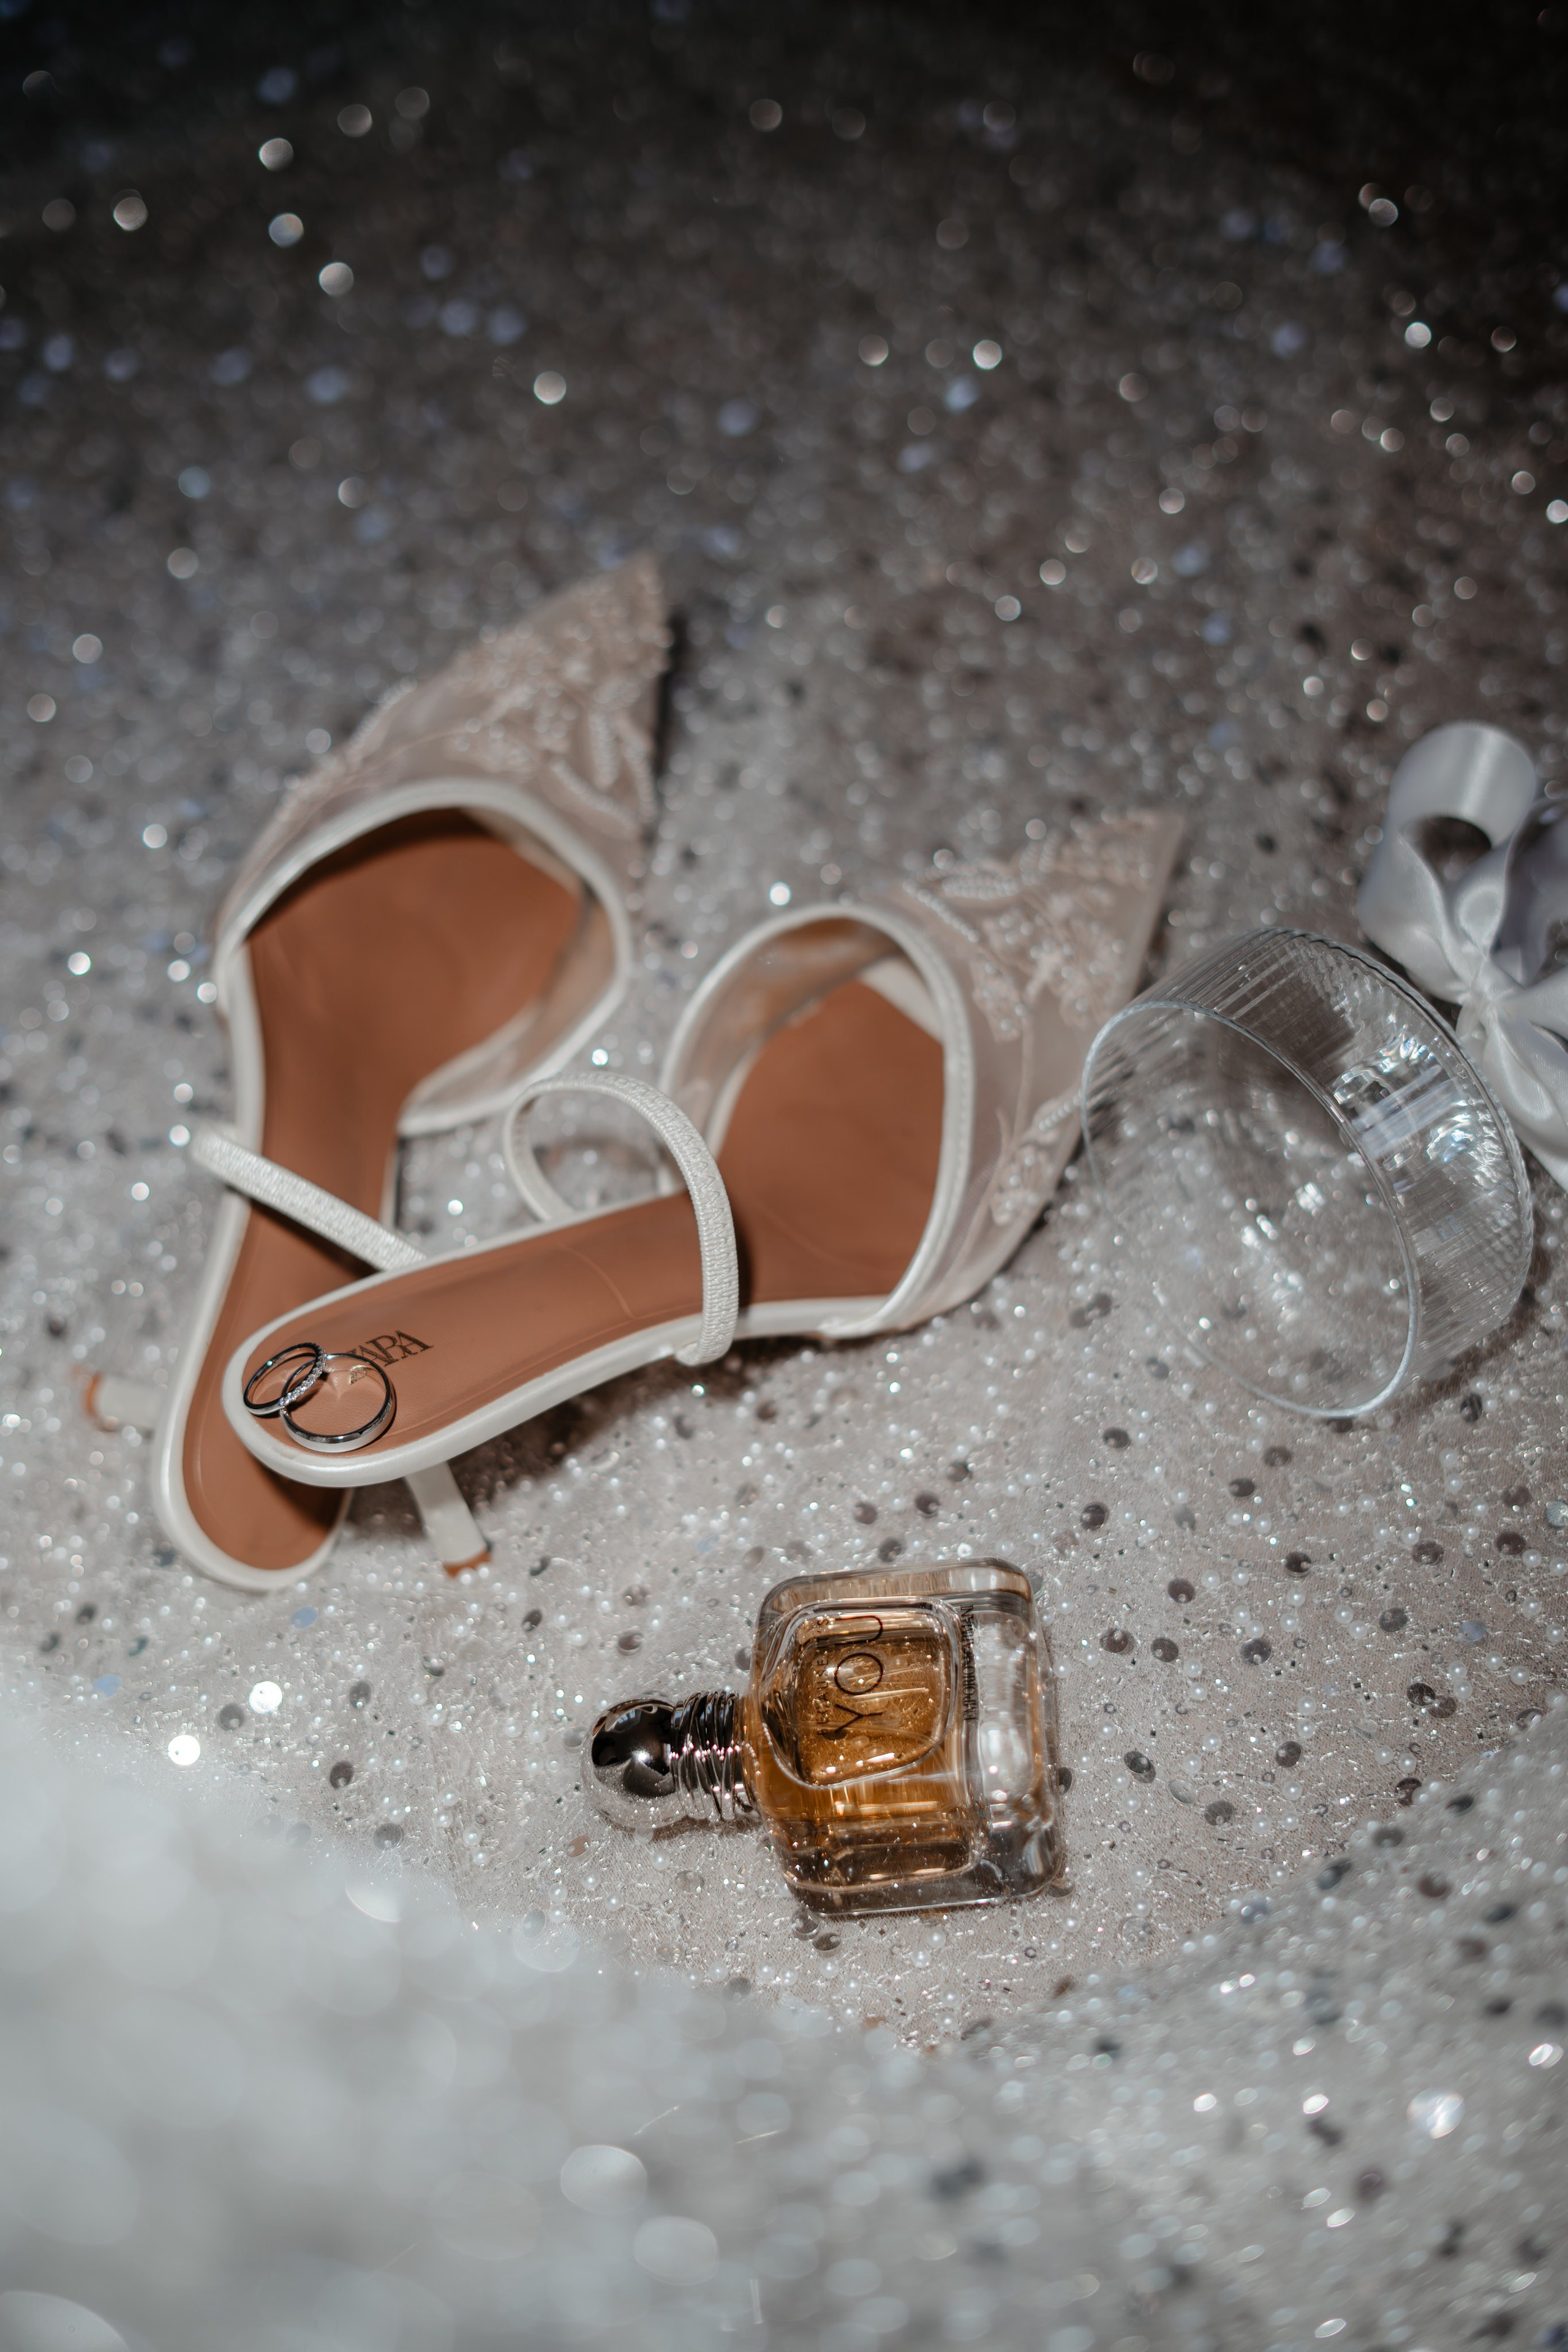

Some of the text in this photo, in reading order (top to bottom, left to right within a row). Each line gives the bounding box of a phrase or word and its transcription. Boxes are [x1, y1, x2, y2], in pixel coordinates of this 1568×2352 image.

[834, 1615, 884, 1733] YOU
[960, 1604, 977, 1722] EMPORIO ARMANI
